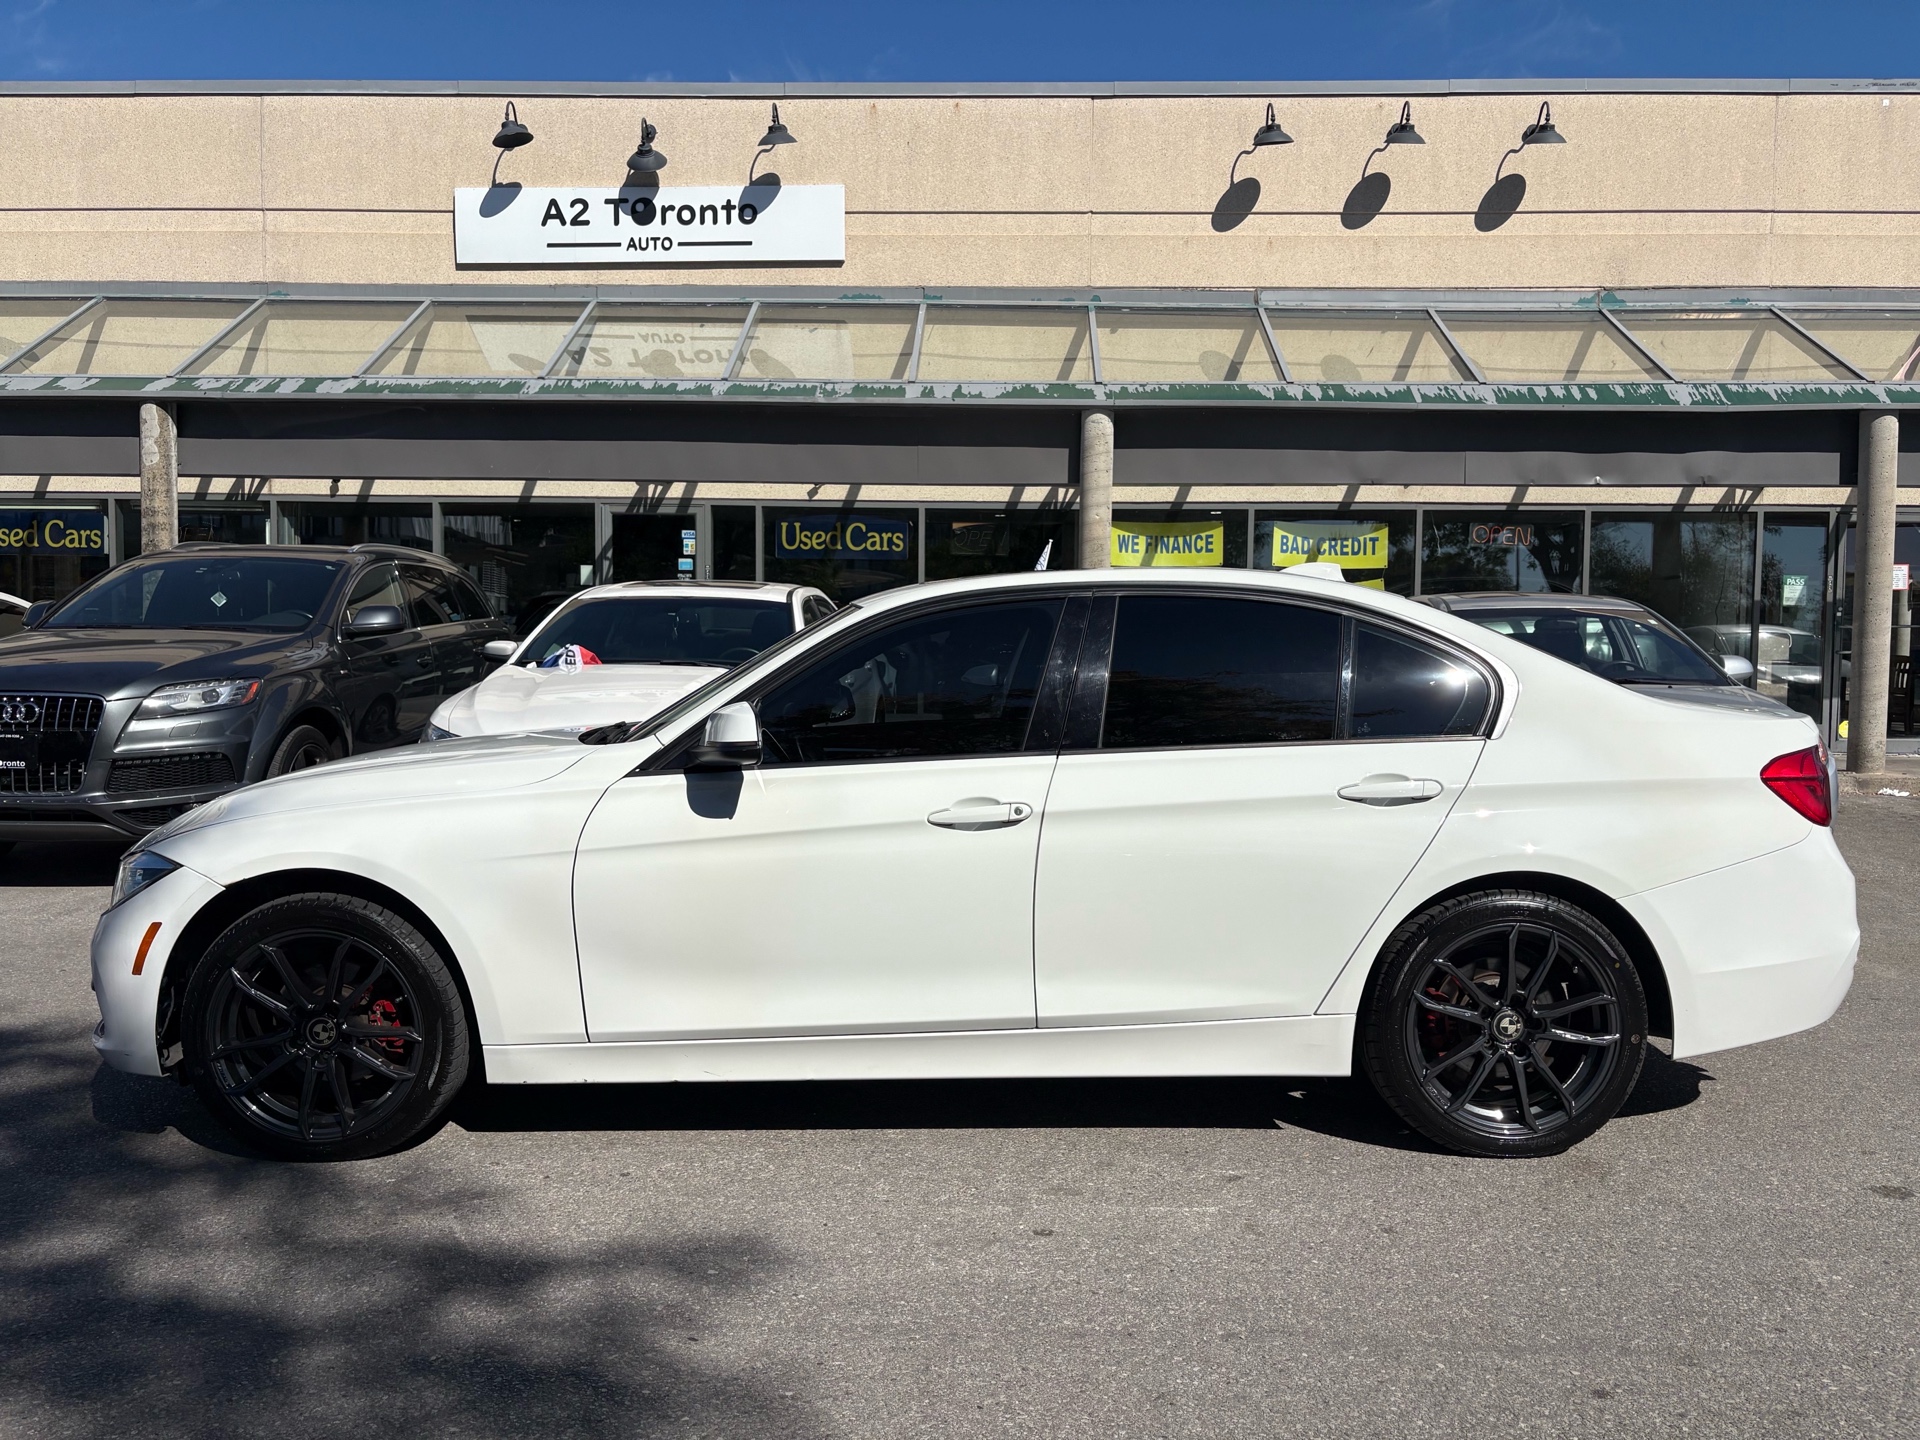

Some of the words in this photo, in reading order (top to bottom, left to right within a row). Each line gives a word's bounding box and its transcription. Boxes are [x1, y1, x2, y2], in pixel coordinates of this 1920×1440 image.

[541, 198, 591, 227] A2
[626, 236, 673, 252] AUTO
[0, 519, 39, 547] sed
[44, 519, 102, 549] Cars
[780, 522, 842, 550] Used
[845, 522, 904, 551] Cars
[1117, 534, 1140, 554] WE
[1145, 533, 1214, 554] FINANCE
[1472, 525, 1531, 545] OPEN
[1279, 534, 1310, 555] BAD
[1317, 536, 1380, 556] CREDIT
[1786, 578, 1805, 586] PASS
[565, 649, 577, 665] ED
